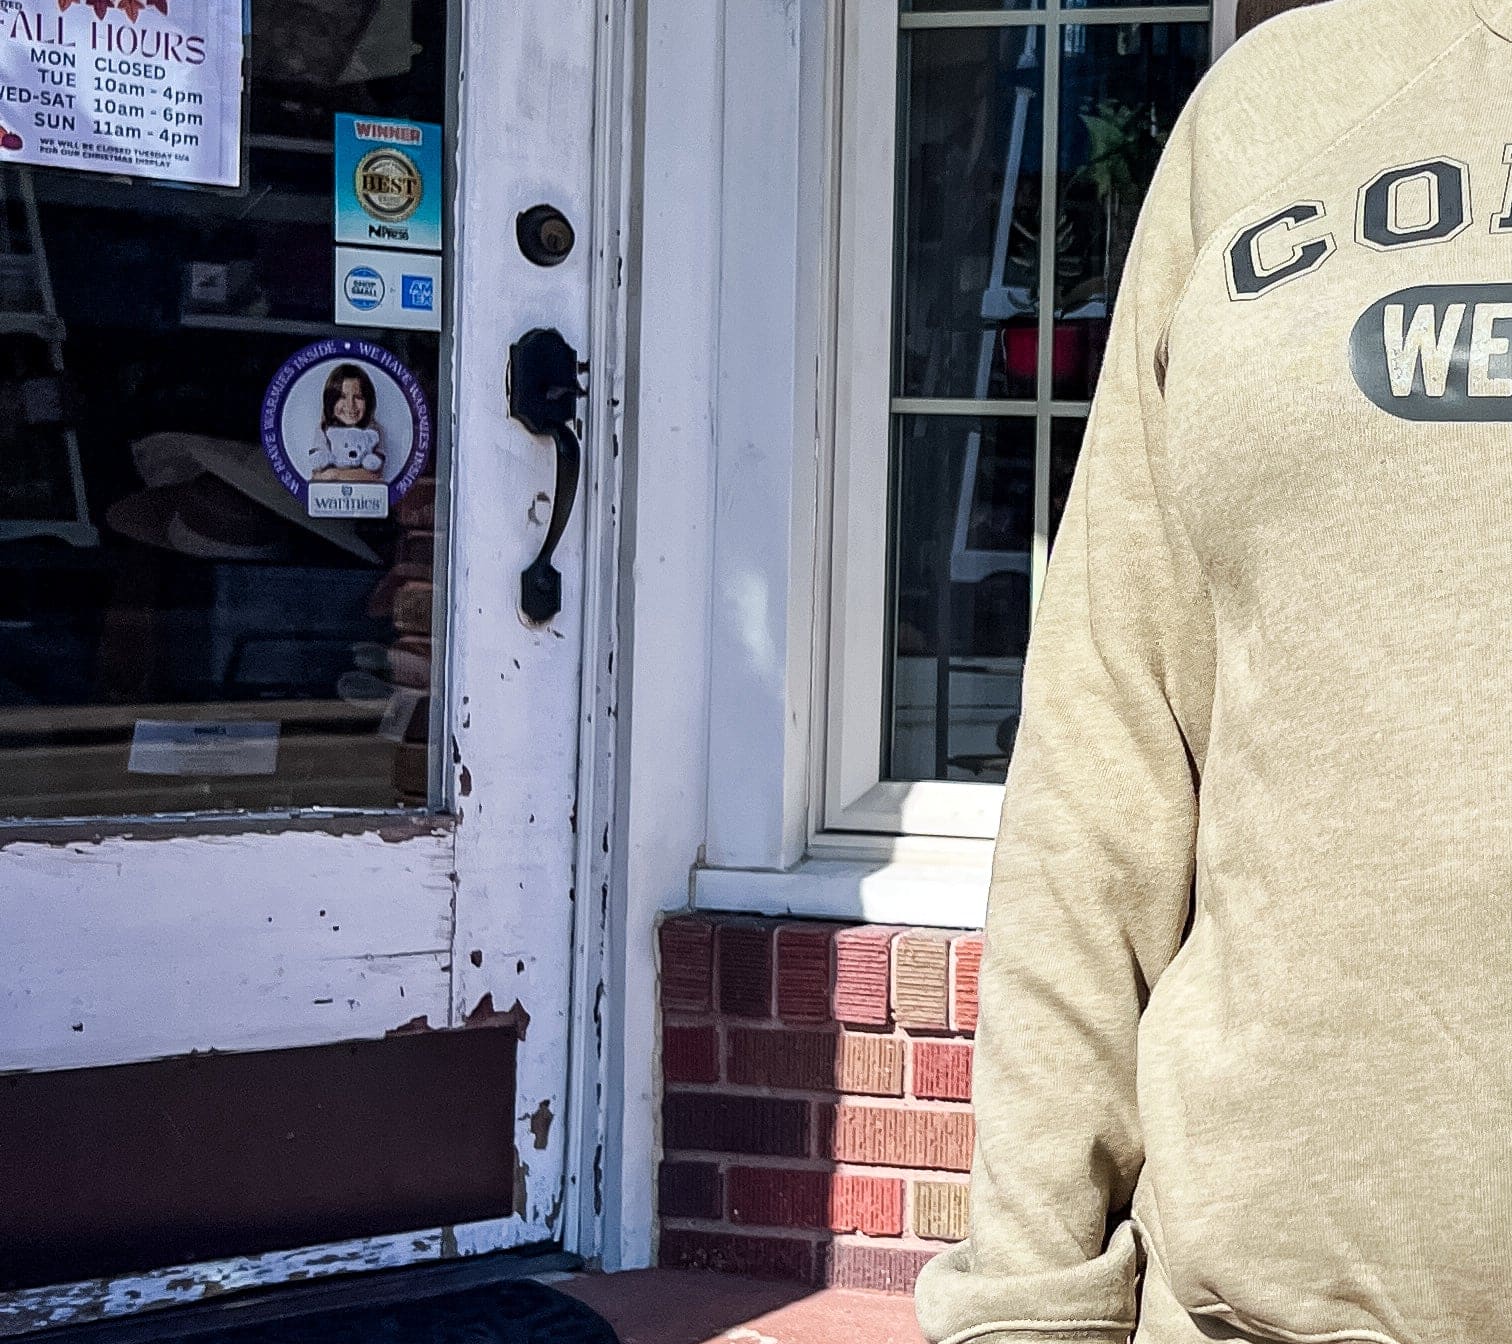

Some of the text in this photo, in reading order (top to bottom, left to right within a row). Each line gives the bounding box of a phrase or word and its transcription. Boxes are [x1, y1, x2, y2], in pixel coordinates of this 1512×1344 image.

[0, 11, 206, 65] ALL HOURS
[31, 48, 166, 80] MON CLOSED
[38, 68, 76, 88] TUE
[94, 77, 145, 97] 10am
[162, 87, 203, 105] 4pm
[93, 98, 144, 118] 10am
[163, 107, 203, 126] 6pm
[34, 112, 75, 131] SUN
[93, 120, 141, 139] 11am
[159, 129, 199, 147] 4pm
[356, 122, 420, 142] WINNER
[40, 138, 54, 146] WE
[58, 140, 78, 149] WILL
[83, 143, 94, 151] BE
[96, 145, 131, 156] CLOSED
[134, 149, 172, 160] TUESDAY
[362, 172, 418, 196] BEST
[315, 496, 380, 511] warmies
